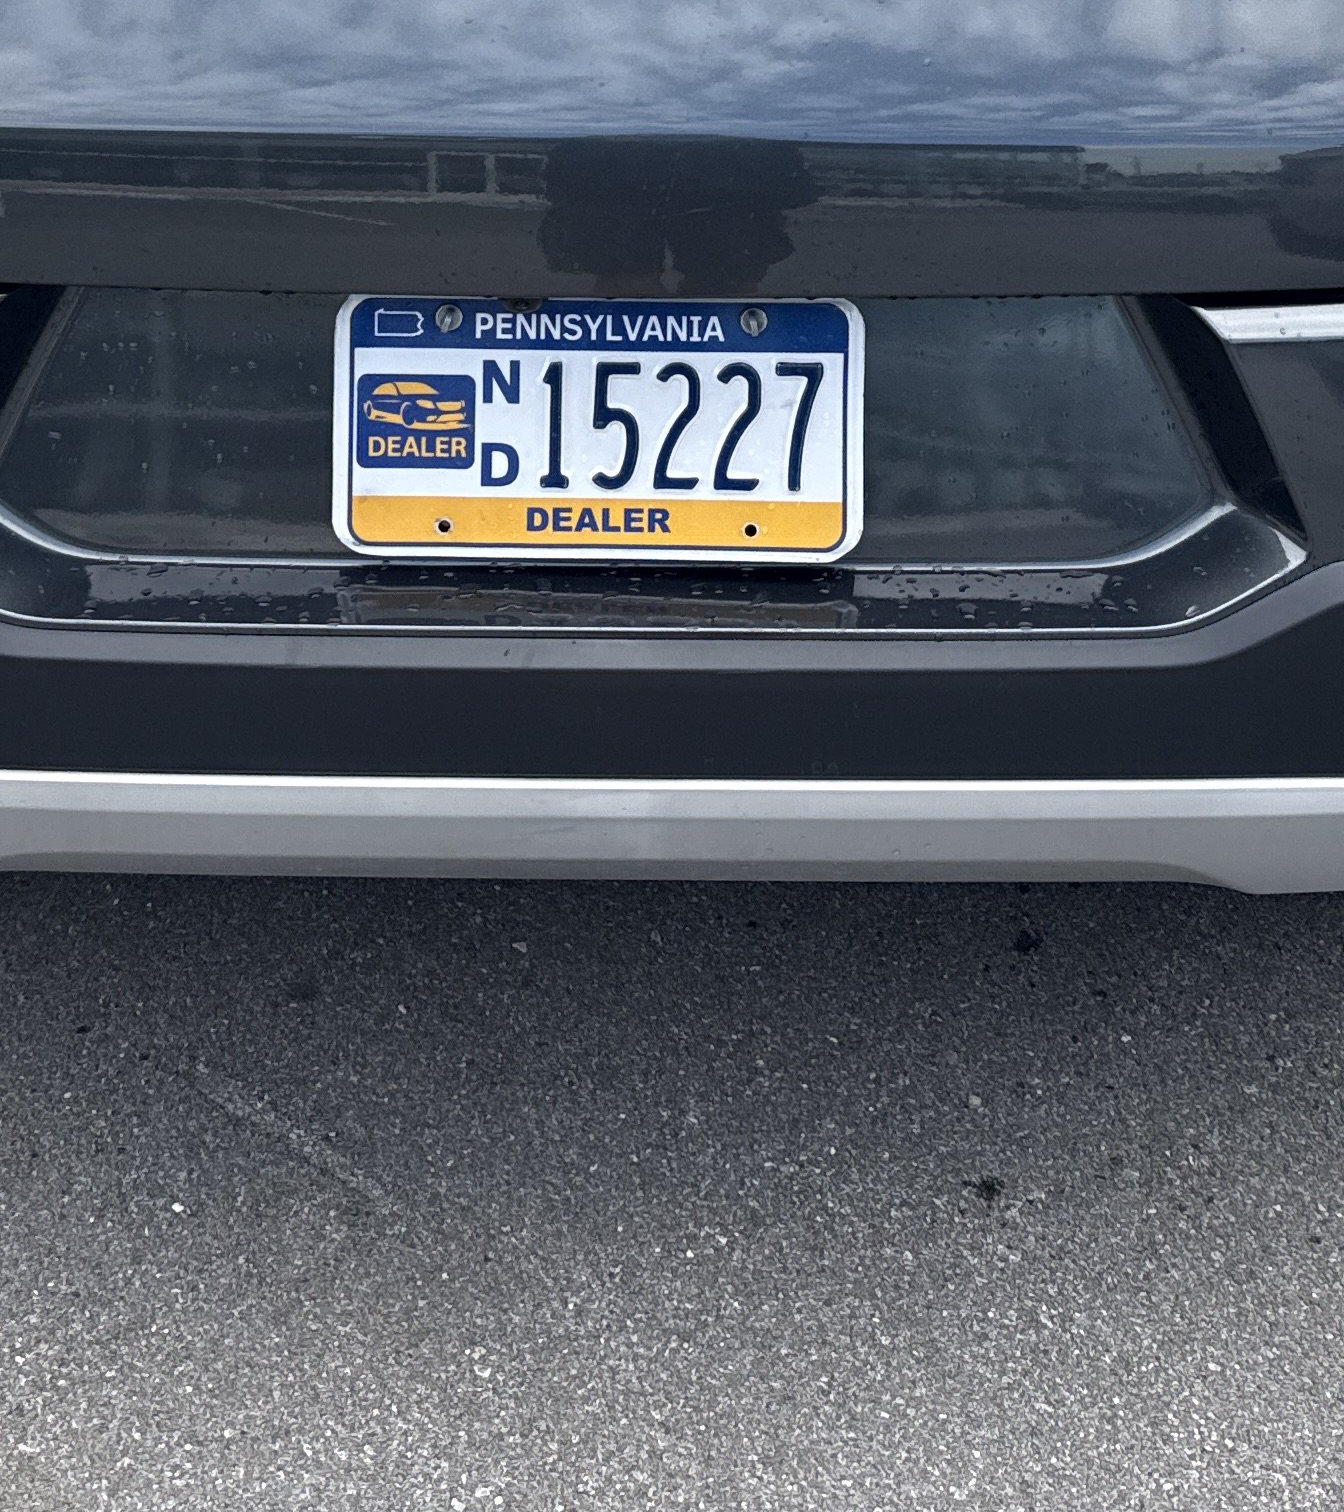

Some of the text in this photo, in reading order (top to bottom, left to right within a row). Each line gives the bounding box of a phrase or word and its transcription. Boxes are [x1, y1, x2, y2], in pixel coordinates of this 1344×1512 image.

[474, 311, 725, 343] PENNSYLVANIA
[539, 360, 825, 493] 15227
[367, 434, 468, 459] DEALER
[525, 506, 672, 534] DEALER
